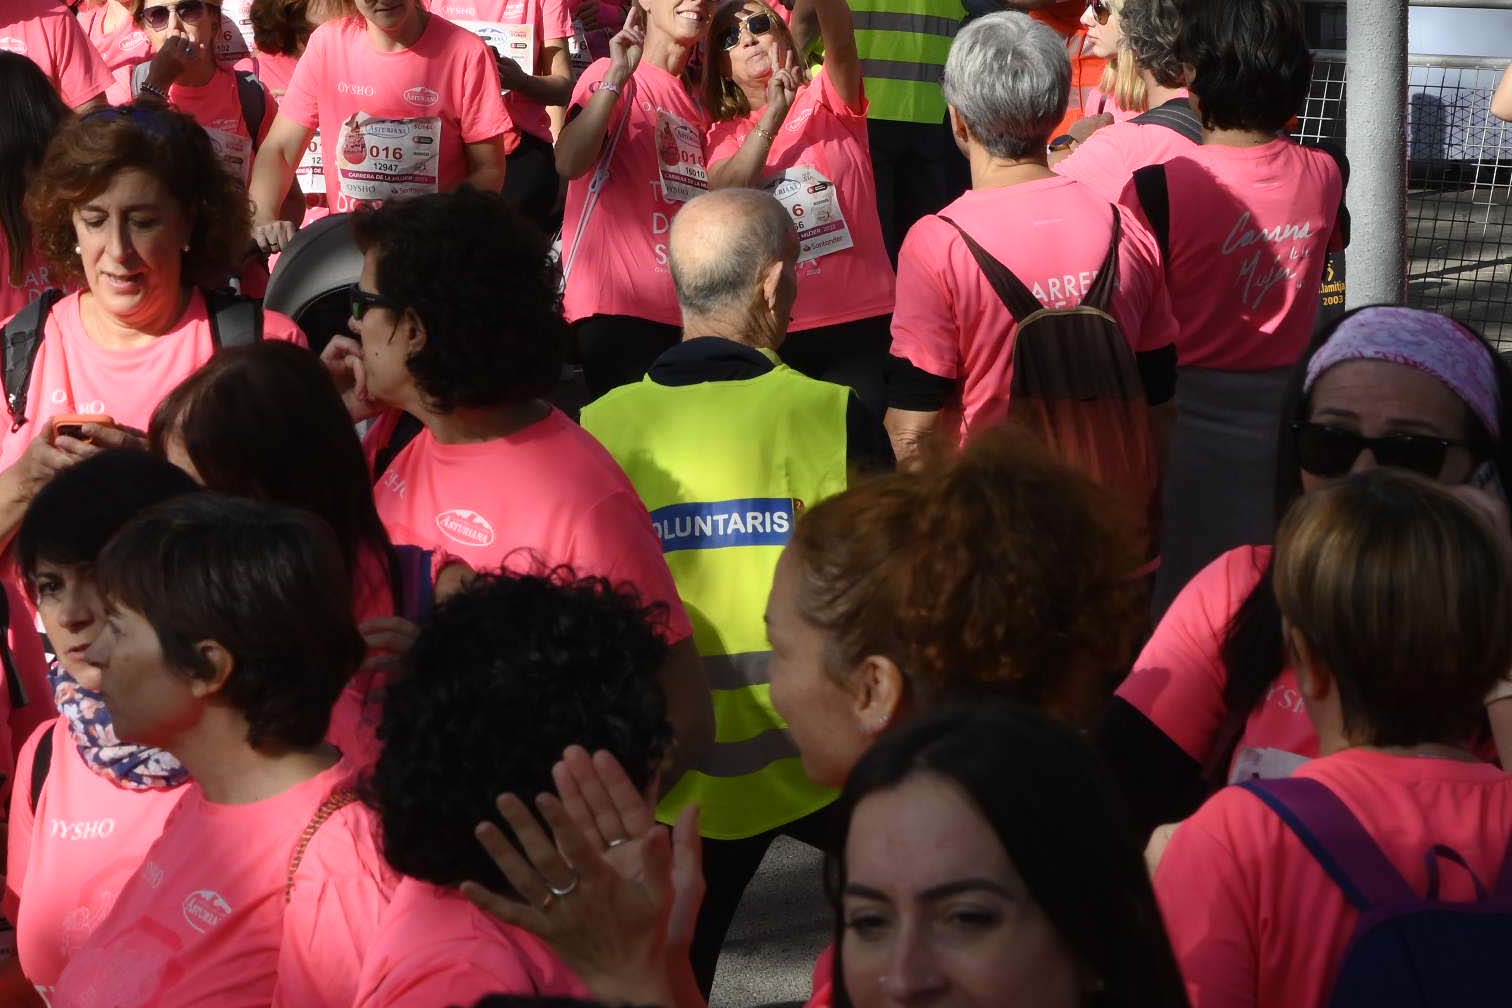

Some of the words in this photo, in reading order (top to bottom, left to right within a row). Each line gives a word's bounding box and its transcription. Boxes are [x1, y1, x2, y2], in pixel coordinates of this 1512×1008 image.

[338, 83, 374, 97] OYSHO
[369, 145, 403, 161] 016
[373, 162, 398, 172] 12947
[347, 183, 376, 193] OYSHO
[792, 203, 804, 218] 6
[1222, 210, 1313, 255] Carrera
